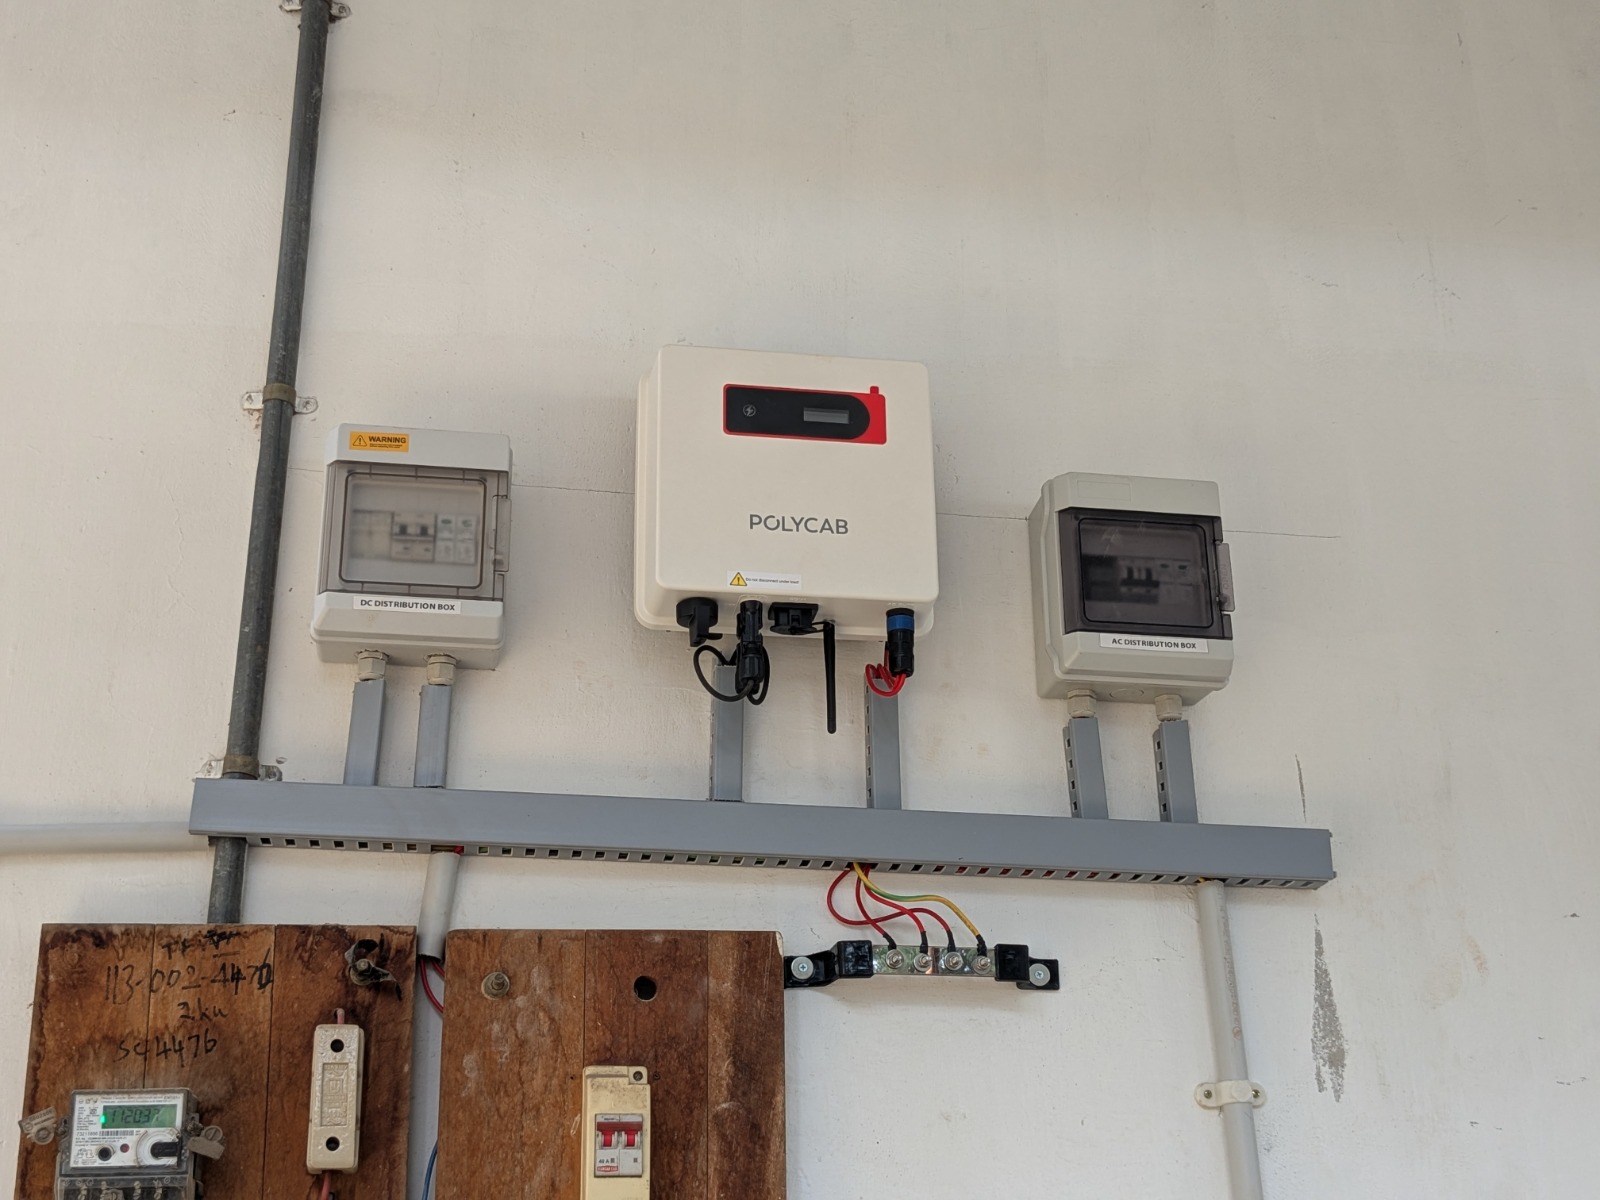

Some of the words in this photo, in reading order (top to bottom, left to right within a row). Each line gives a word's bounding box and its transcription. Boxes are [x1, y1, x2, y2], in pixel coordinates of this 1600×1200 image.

[368, 436, 407, 444] WARNING
[749, 513, 849, 535] POLYCAB
[360, 599, 373, 607] DC
[374, 600, 436, 610] DISTRIBUTION
[437, 603, 456, 611] BOX
[1124, 639, 1180, 649] DISTRIBUTION
